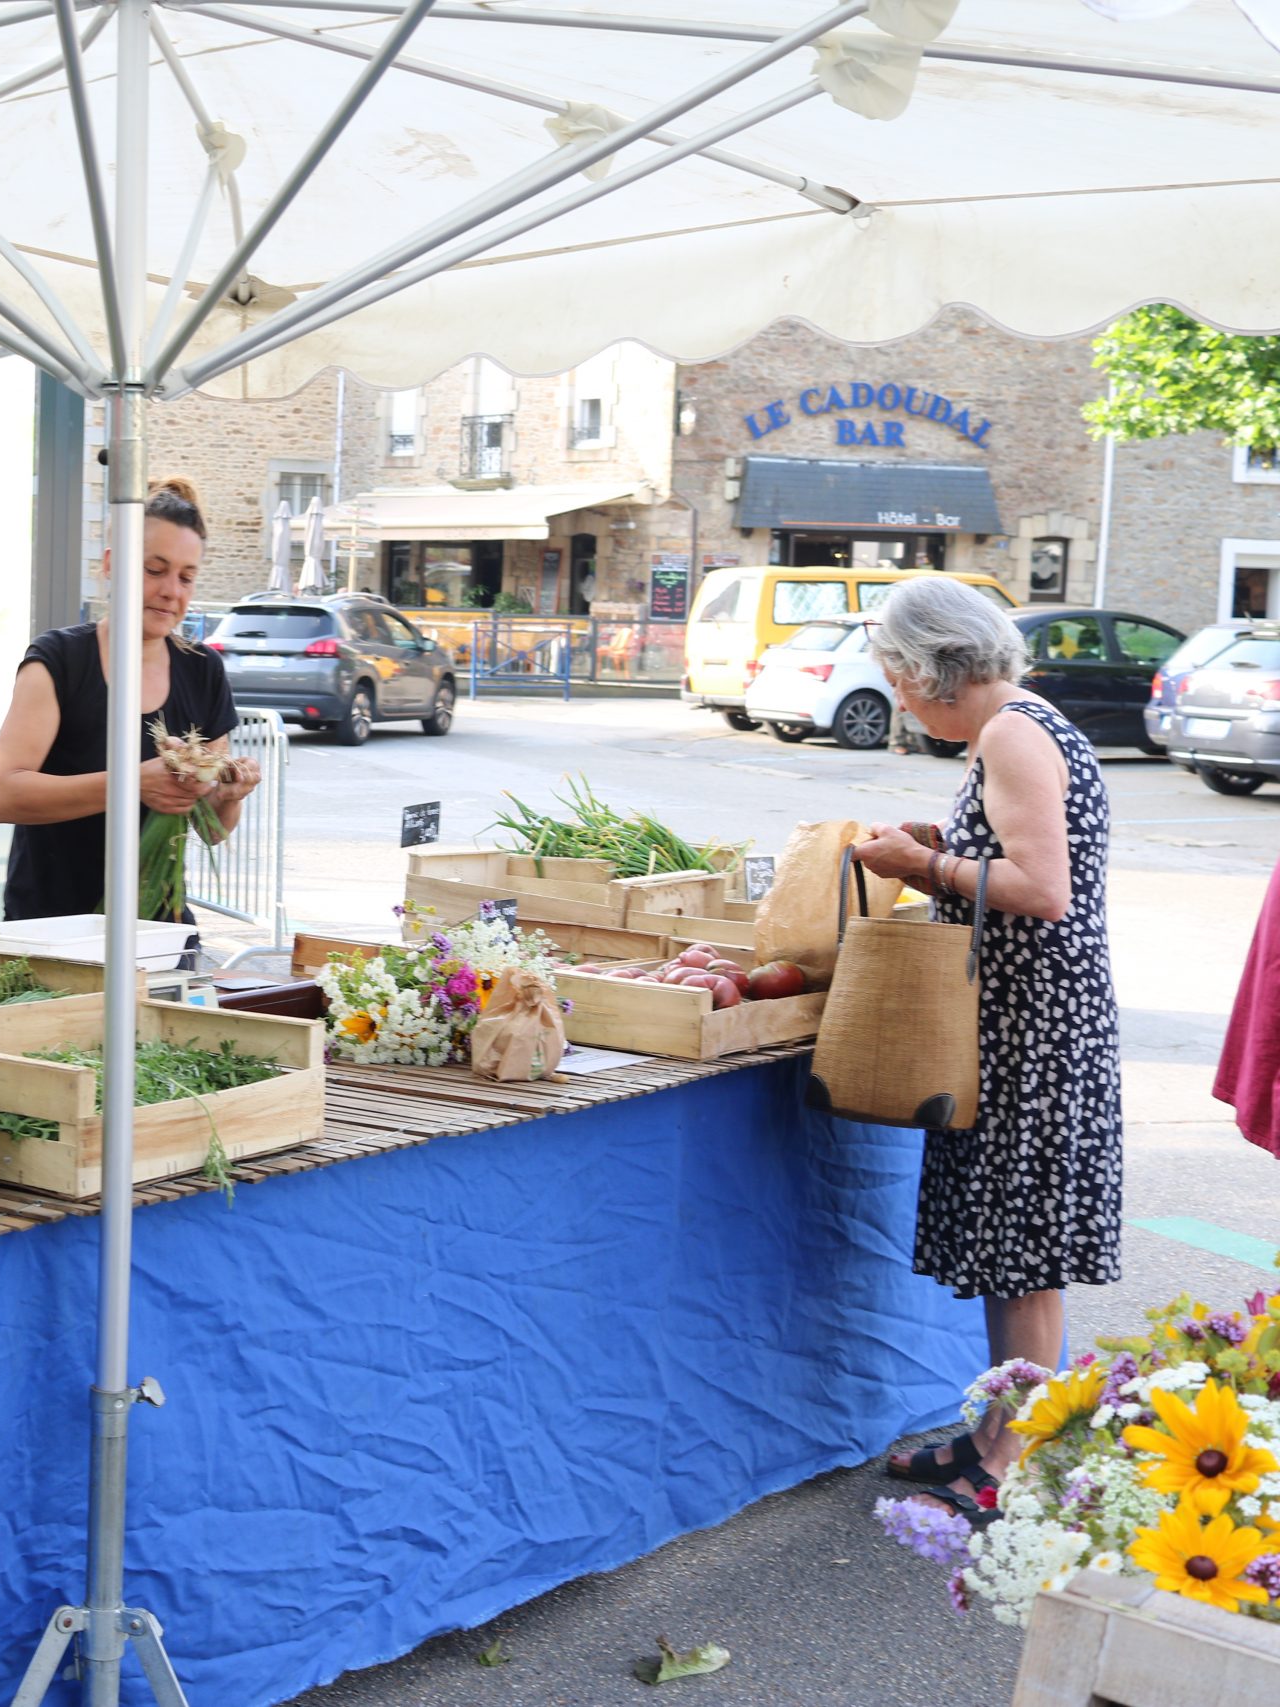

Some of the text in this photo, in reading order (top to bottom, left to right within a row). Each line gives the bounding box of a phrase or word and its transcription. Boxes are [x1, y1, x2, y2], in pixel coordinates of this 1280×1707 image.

[744, 382, 992, 450] LE CADOUDAL
[835, 419, 906, 448] BAR
[877, 511, 917, 526] Hôtel
[935, 513, 961, 527] Bar
